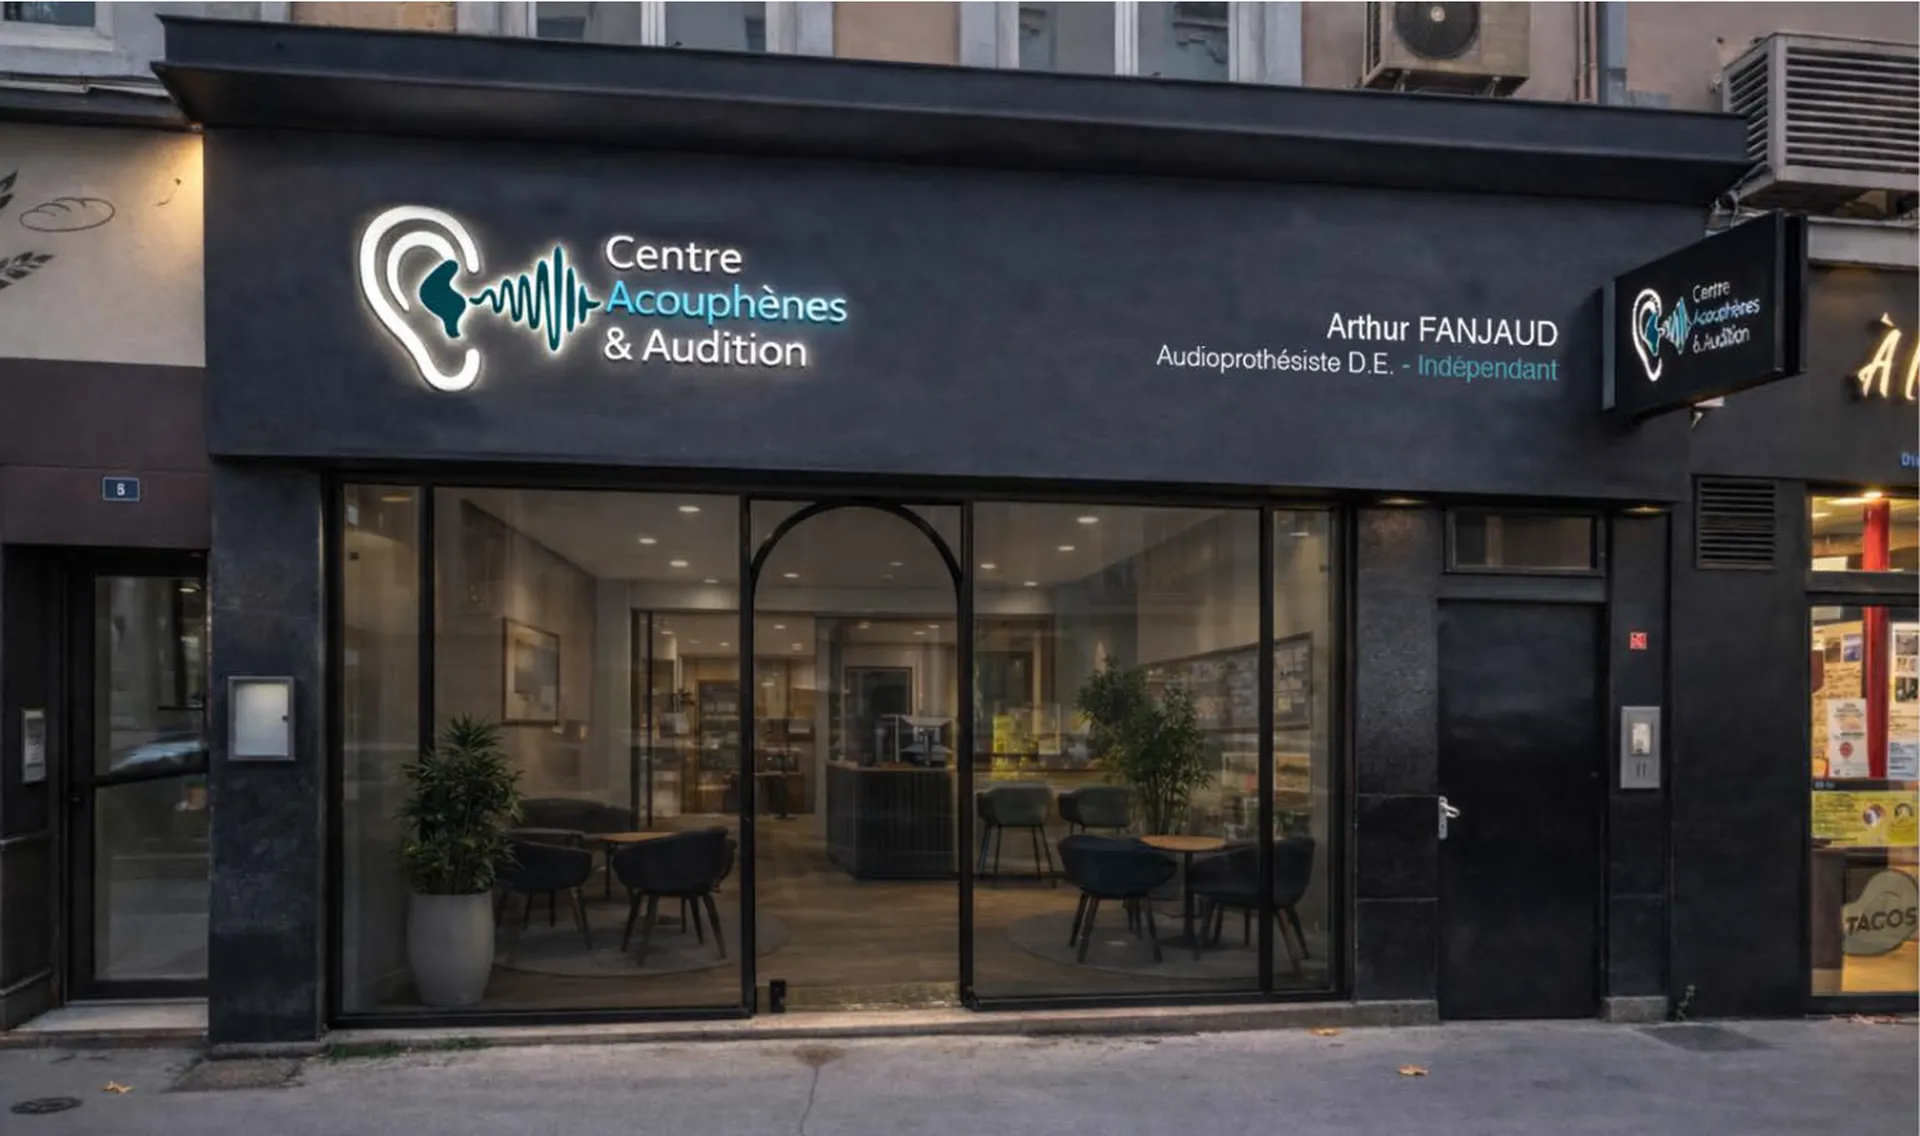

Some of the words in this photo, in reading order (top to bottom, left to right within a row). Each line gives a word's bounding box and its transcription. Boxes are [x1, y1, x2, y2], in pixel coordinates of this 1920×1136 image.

[606, 234, 742, 274] Centre
[605, 280, 848, 326] Acouphènes
[603, 328, 633, 361] &
[642, 328, 808, 367] Audition
[1326, 312, 1411, 342] Arthur
[1419, 315, 1559, 347] FANJAUD
[1156, 344, 1341, 374] Audioprothésiste
[1348, 350, 1395, 375] D.E.
[1418, 353, 1558, 383] Indépendant
[1857, 312, 1902, 398] À
[1846, 906, 1918, 936] TACOS
